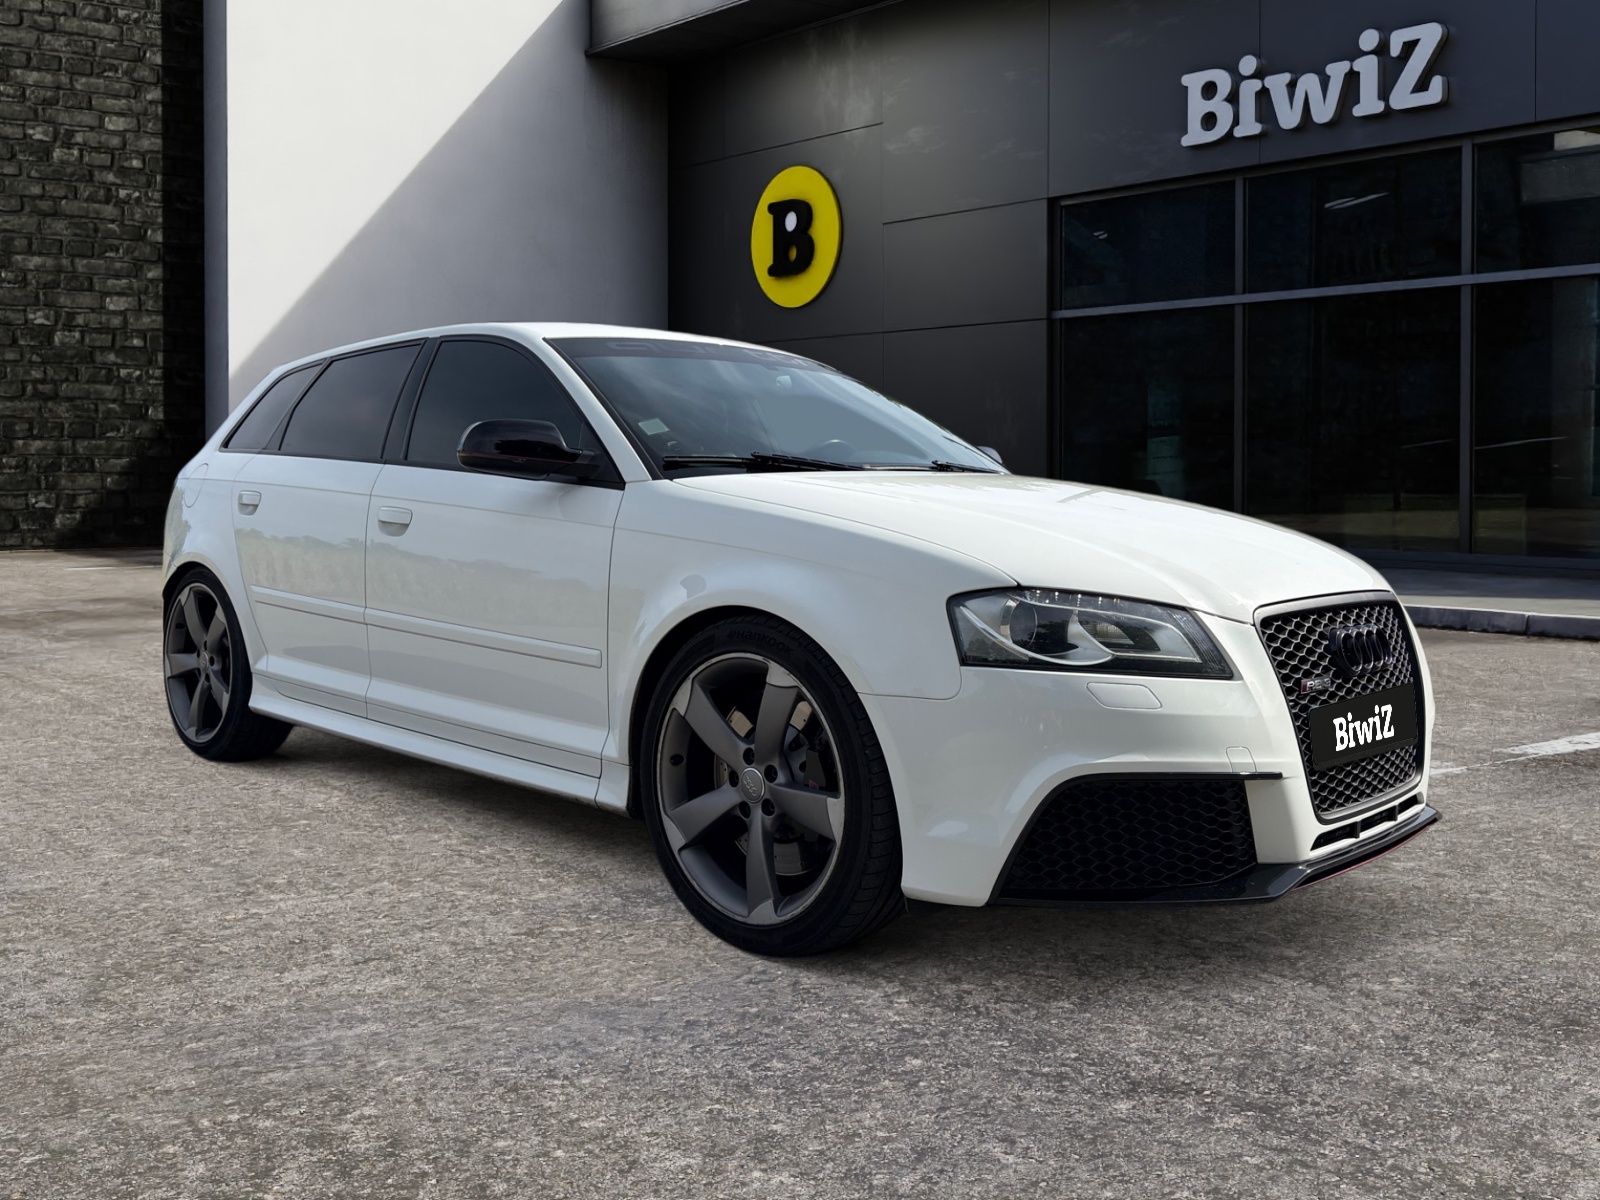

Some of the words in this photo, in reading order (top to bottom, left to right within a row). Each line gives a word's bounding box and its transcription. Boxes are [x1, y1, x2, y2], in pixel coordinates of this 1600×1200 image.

[1181, 22, 1447, 147] BiwiZ
[767, 199, 815, 277] B
[1332, 704, 1394, 751] BiwiZ
